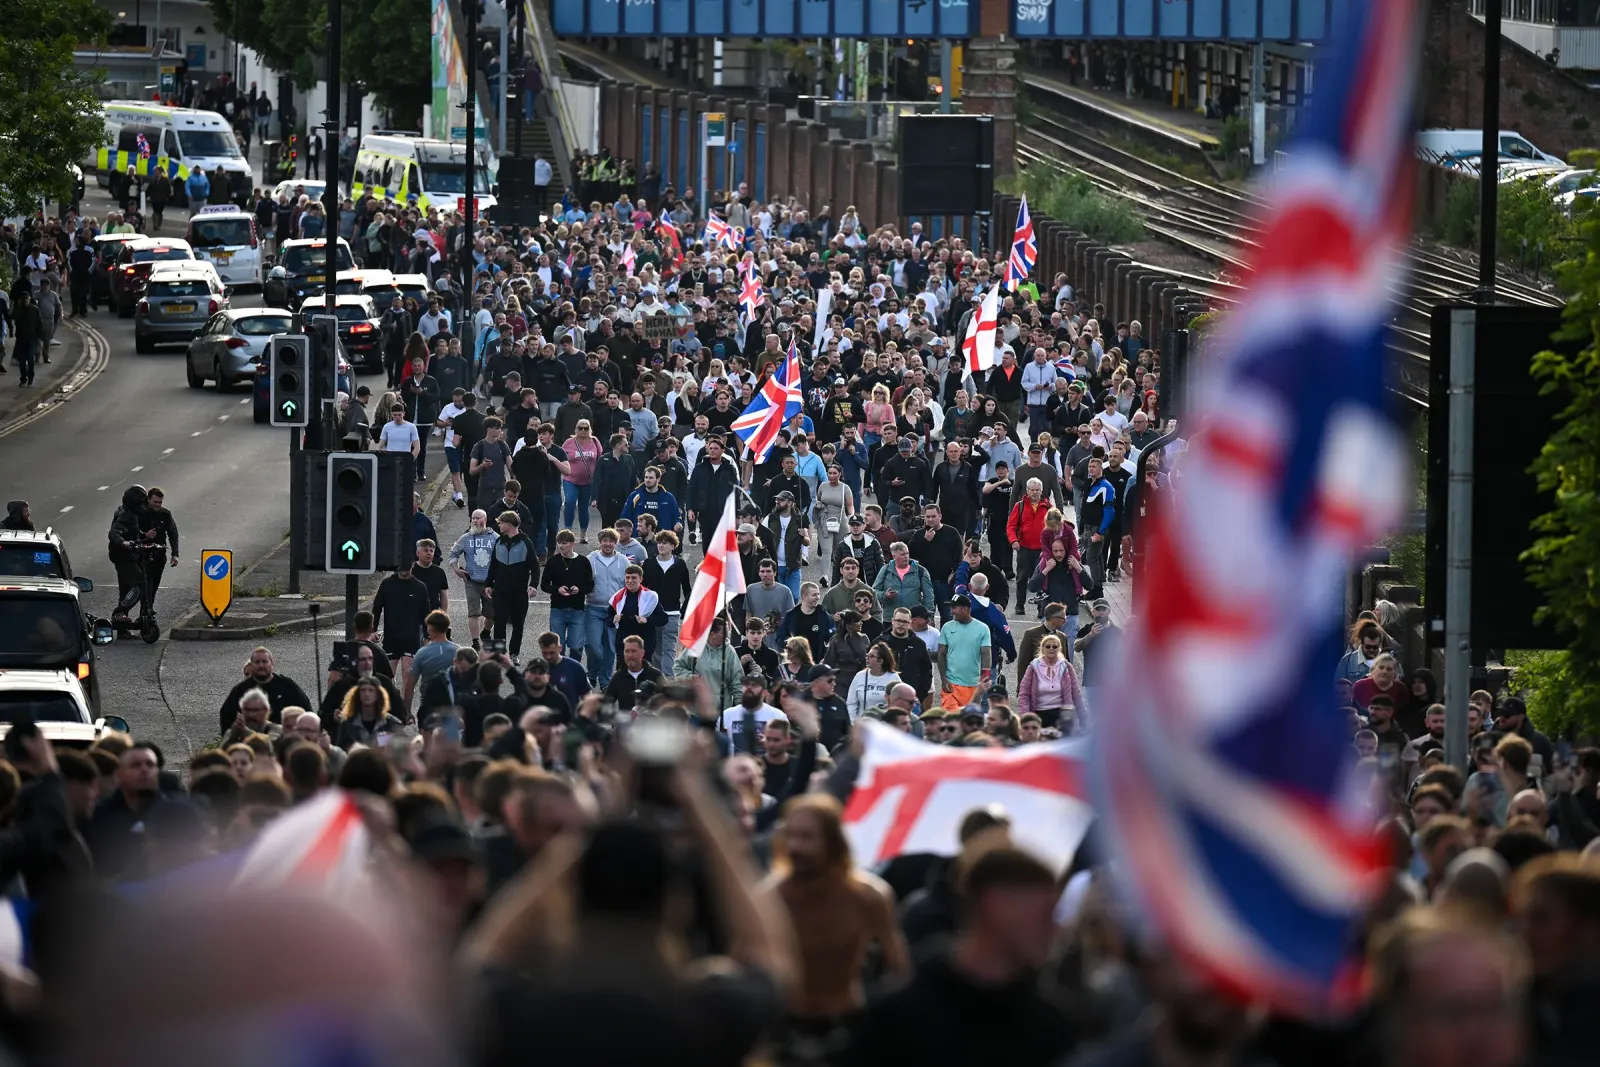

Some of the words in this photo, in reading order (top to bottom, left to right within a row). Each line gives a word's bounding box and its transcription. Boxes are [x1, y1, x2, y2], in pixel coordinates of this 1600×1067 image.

[117, 112, 152, 123] POLICE
[645, 318, 676, 328] HENRY
[469, 538, 493, 548] UCLA
